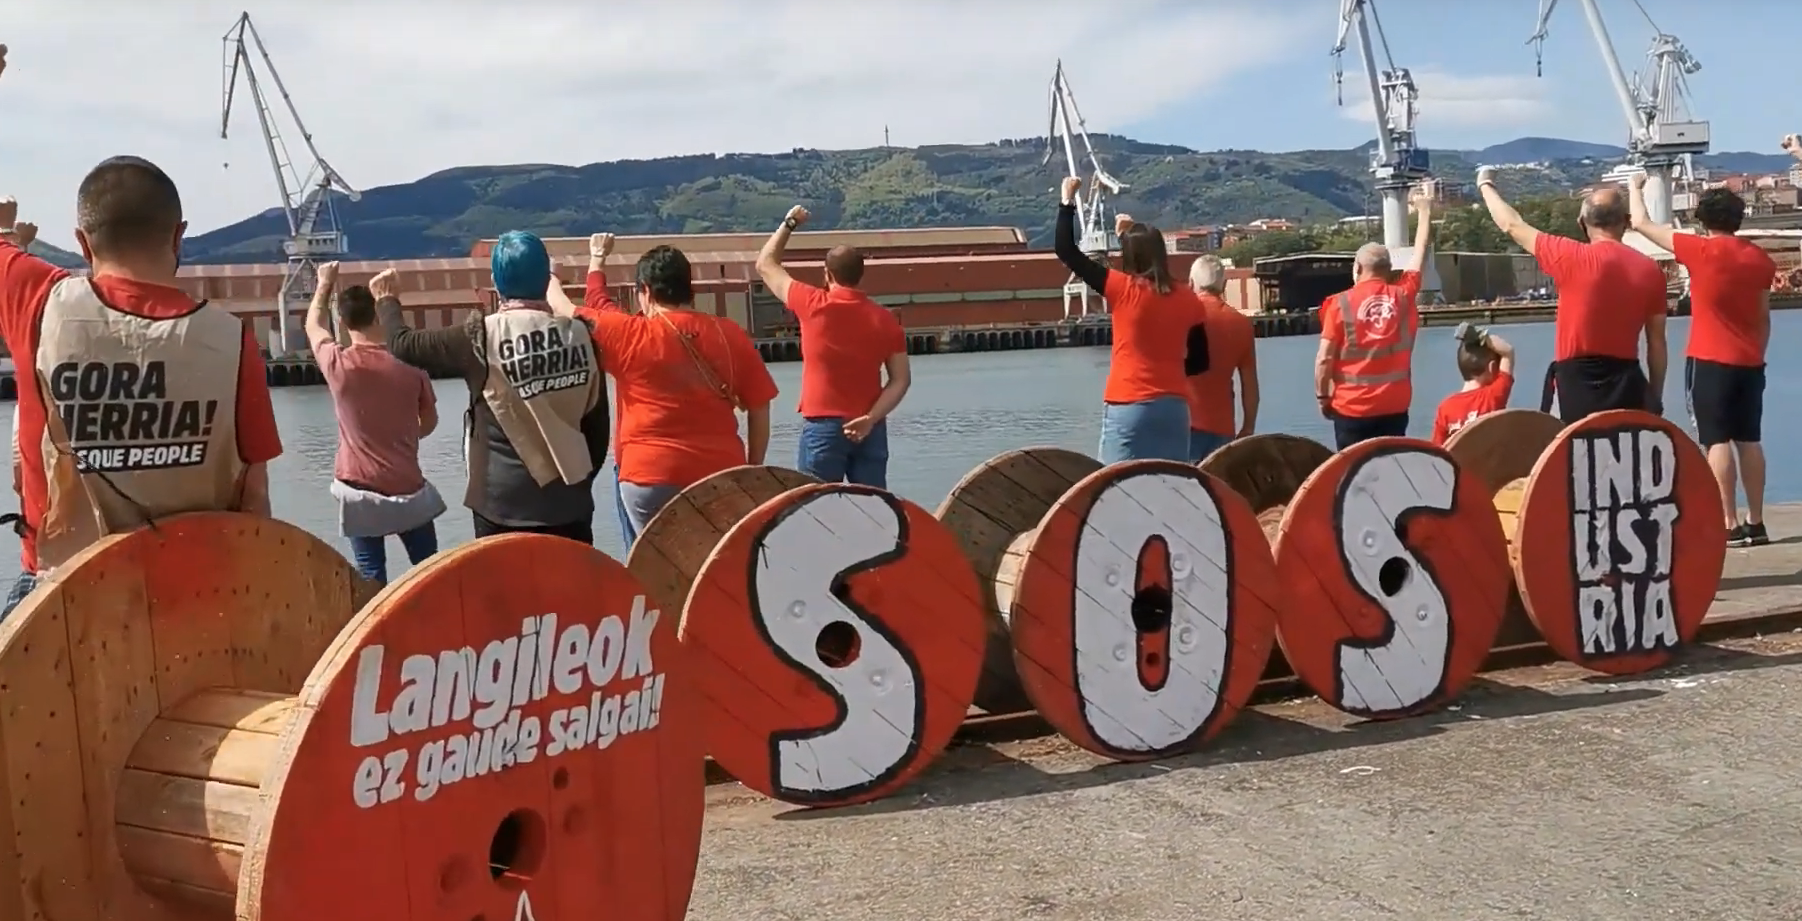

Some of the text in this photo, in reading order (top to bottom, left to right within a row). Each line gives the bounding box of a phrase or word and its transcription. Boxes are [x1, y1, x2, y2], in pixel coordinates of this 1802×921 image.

[500, 325, 563, 361] GORA
[501, 343, 590, 383] HERRIA!
[51, 360, 166, 401] GORA
[546, 372, 586, 390] PEOPLE
[127, 443, 204, 467] PEOPLE
[351, 594, 660, 747] Langileok
[353, 672, 666, 809] ez gaude salgai!
